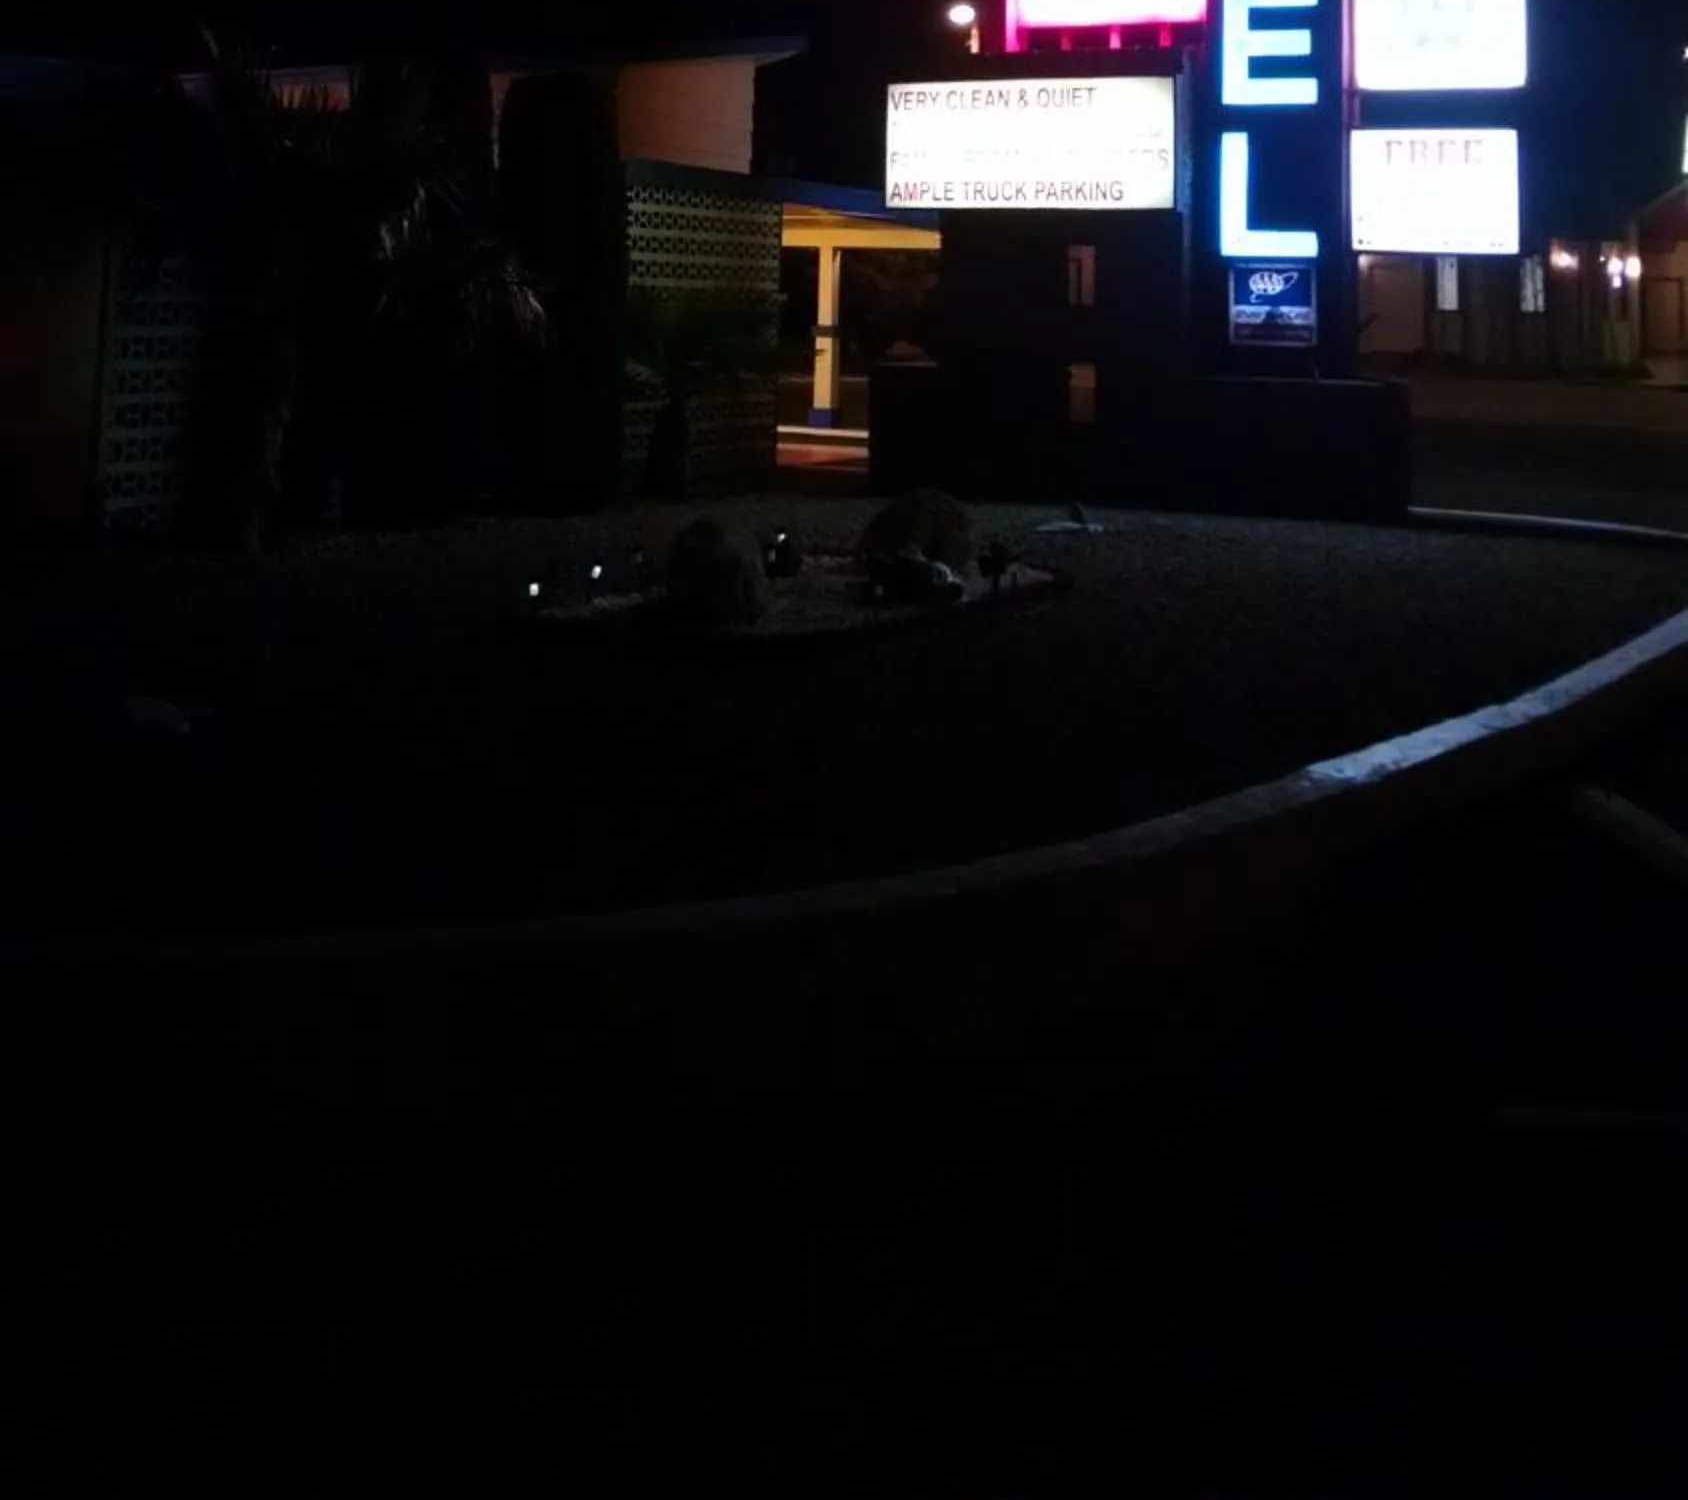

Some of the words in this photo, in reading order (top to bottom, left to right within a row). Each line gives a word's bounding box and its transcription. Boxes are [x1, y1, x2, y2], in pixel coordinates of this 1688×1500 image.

[890, 90, 940, 112] VERY
[945, 88, 1010, 110] CLEAN
[1016, 87, 1029, 109] &
[1036, 86, 1097, 109] QUIET
[890, 181, 956, 202] AMPLE
[962, 180, 1028, 202] TRUCK
[1033, 179, 1125, 202] PARKING
